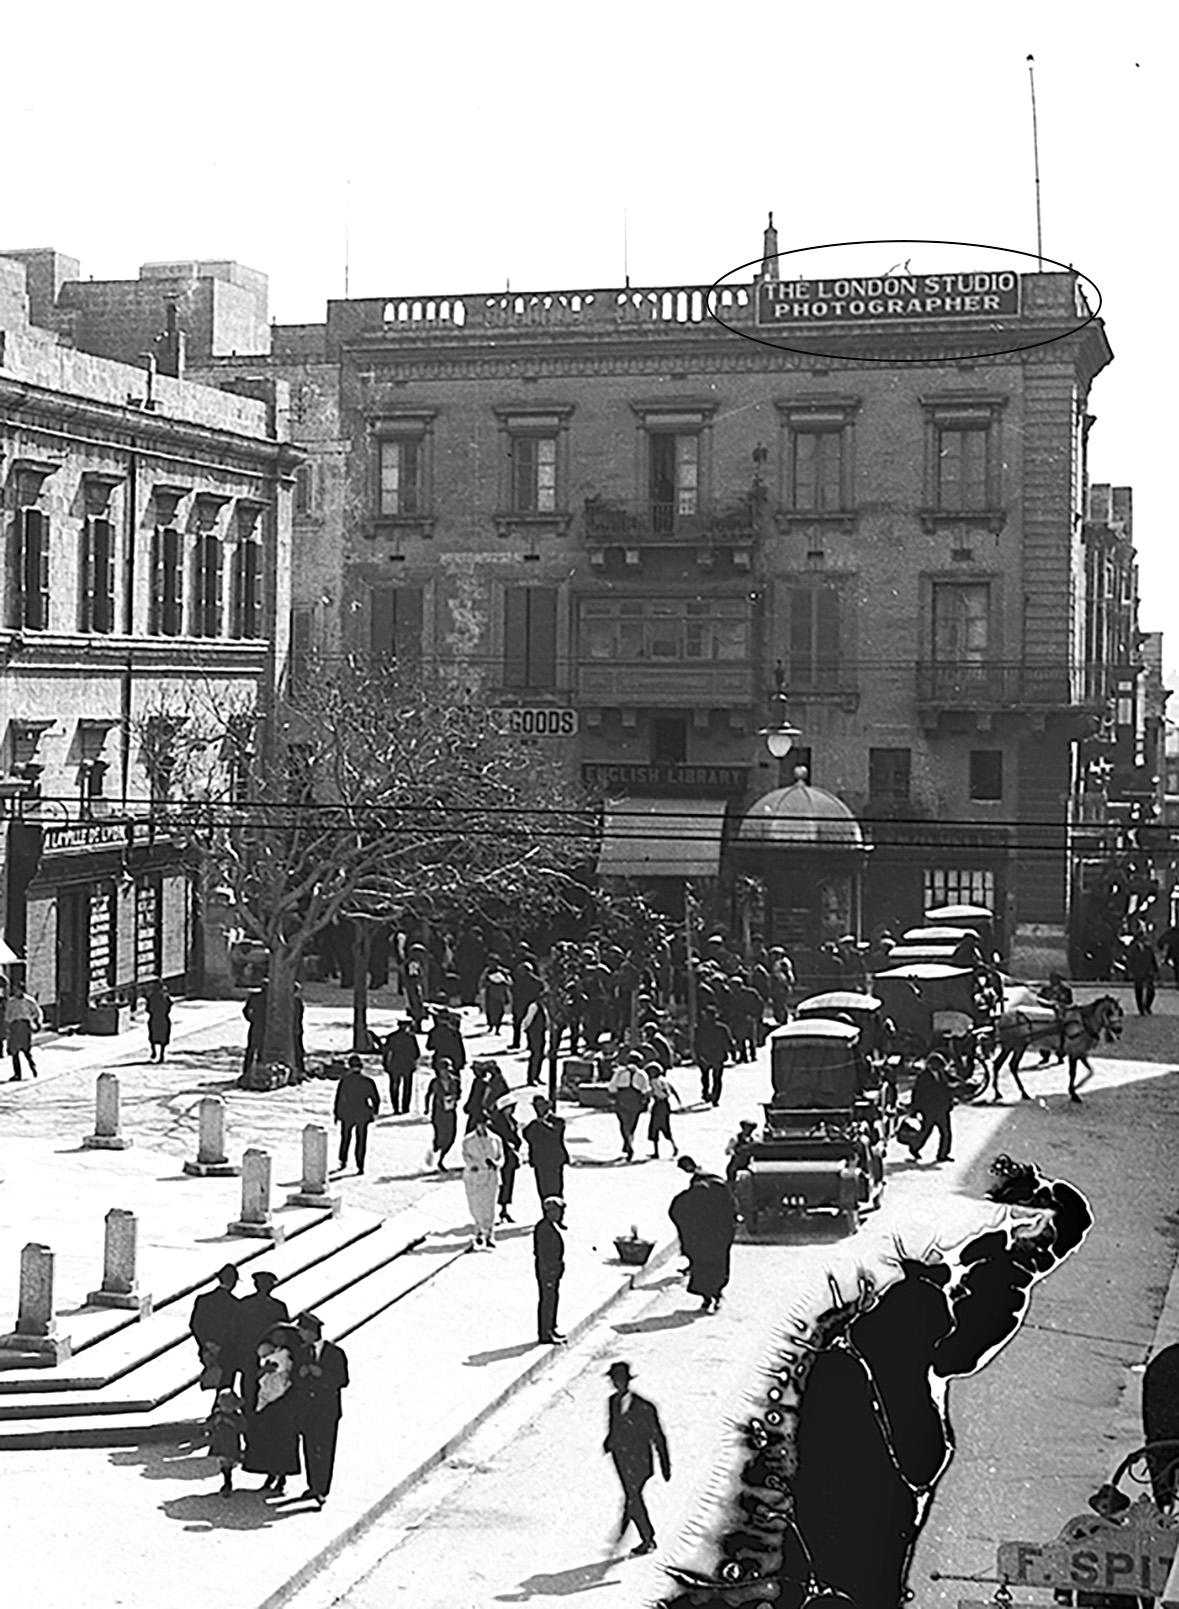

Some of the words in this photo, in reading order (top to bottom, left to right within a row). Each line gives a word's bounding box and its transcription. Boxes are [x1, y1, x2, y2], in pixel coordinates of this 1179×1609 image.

[763, 281, 810, 300] THE
[818, 277, 917, 299] LONDON
[924, 273, 1015, 294] STUDIO
[774, 295, 1001, 318] PHOTOGRAPHER
[510, 710, 573, 734] GOODS
[585, 766, 660, 784] ENGLISH
[667, 767, 743, 785] LIBRARY
